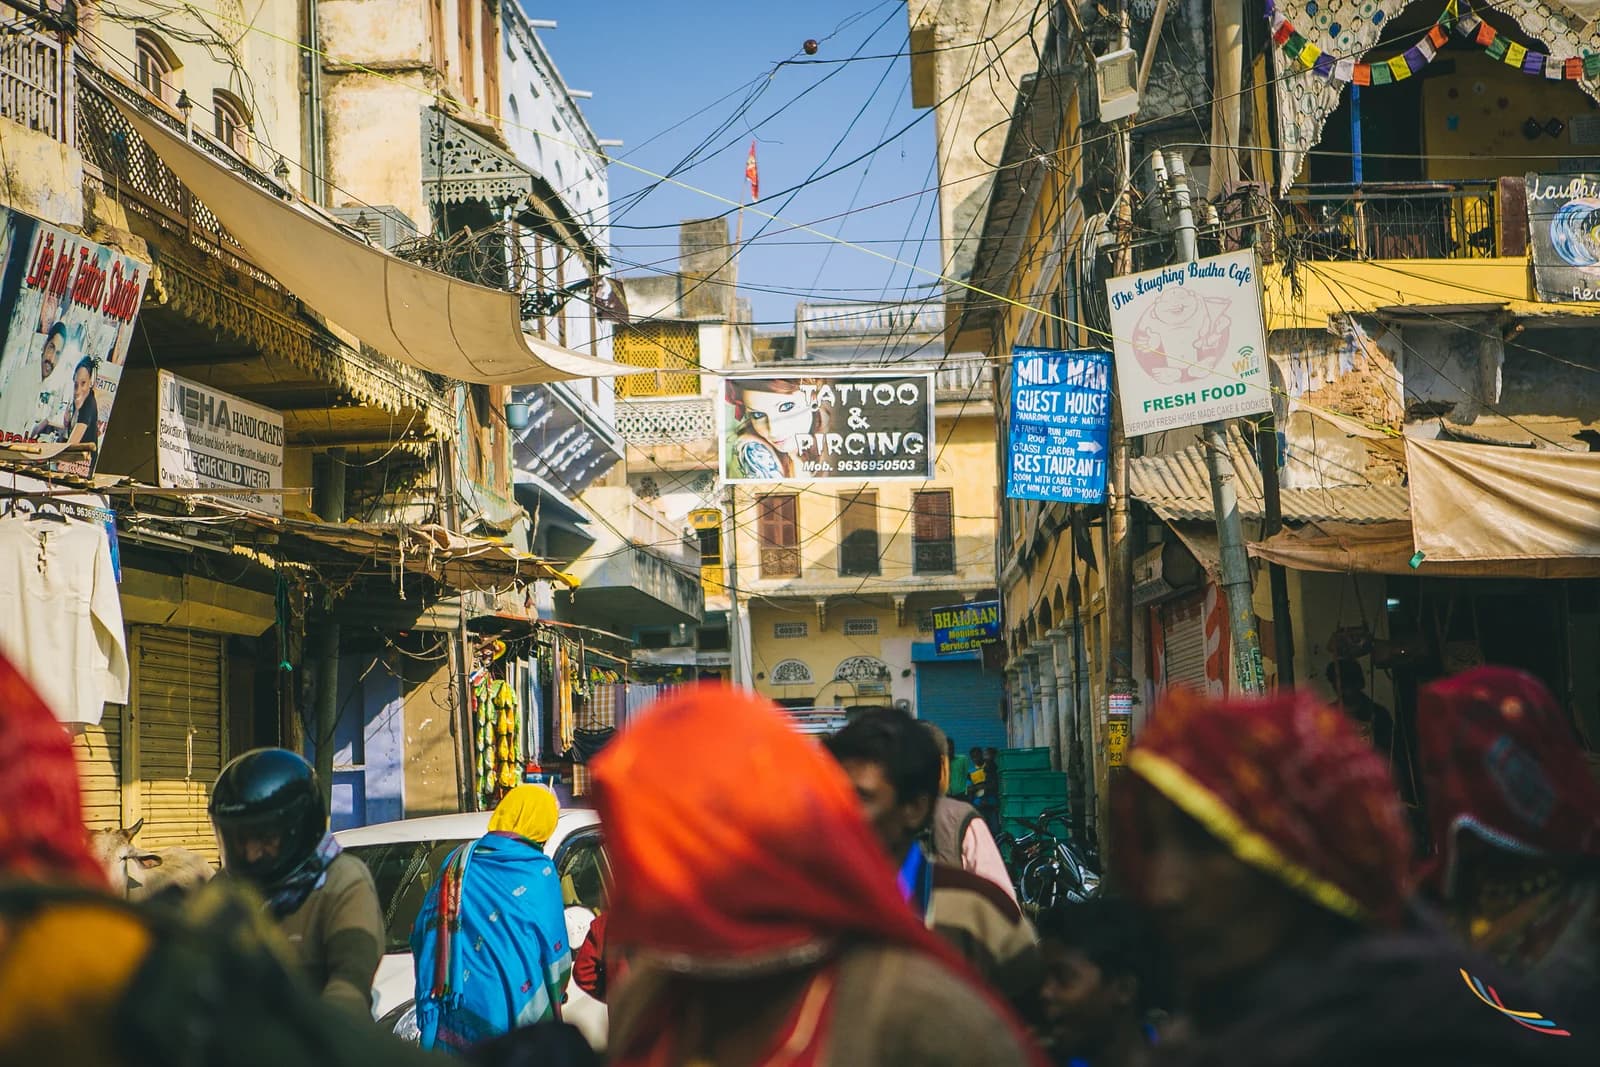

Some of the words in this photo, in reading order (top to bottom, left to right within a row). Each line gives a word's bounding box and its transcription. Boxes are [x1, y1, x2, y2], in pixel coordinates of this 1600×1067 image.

[1530, 174, 1600, 201] Laughi
[26, 230, 54, 292] Life
[49, 239, 75, 300] Ink
[70, 247, 107, 313] Tattoo
[103, 260, 140, 325] Studio
[1111, 291, 1134, 310] The
[1134, 267, 1185, 295] Laughing
[1188, 262, 1225, 278] Budha
[1229, 263, 1252, 286] Cafe
[1017, 357, 1061, 387] MILK
[1067, 358, 1108, 391] MAN
[1240, 368, 1260, 379] FREE
[800, 383, 919, 407] TATTOO
[1016, 390, 1060, 413] GUEST
[1065, 392, 1107, 415] HOUSE
[1143, 392, 1196, 413] FRESH
[1202, 382, 1246, 402] FOOD
[169, 382, 233, 433] NEHA
[847, 407, 870, 430] &
[1125, 420, 1157, 433] EVERYDAY
[1157, 415, 1177, 426] FRESH
[1178, 411, 1196, 423] HOME
[1198, 407, 1216, 419] MADE
[1217, 404, 1233, 415] CAKE
[1241, 398, 1270, 410] COOKIES
[1053, 415, 1067, 423] VIEW
[1070, 416, 1078, 424] OF
[1082, 417, 1105, 425] NATURE
[1021, 425, 1043, 434] FAMILY
[1047, 427, 1061, 436] RUN
[1065, 428, 1082, 438] HOTEL
[1027, 434, 1047, 444] ROOF
[1053, 436, 1067, 445] TOP
[795, 432, 924, 456] PIRCING
[1046, 446, 1075, 456] GARDEN
[184, 449, 217, 476] MEGHA
[217, 457, 242, 483] CHILD
[243, 467, 270, 488] WEAR
[803, 461, 833, 472] Mob.
[837, 460, 915, 471] 9636950503
[1014, 455, 1104, 477] RESTAURANT
[1012, 483, 1026, 494] A/C
[1027, 484, 1040, 492] NON
[1041, 485, 1050, 496] AC
[1052, 485, 1061, 493] RS
[1062, 486, 1072, 497] 100
[1013, 473, 1031, 482] ROOM
[1035, 475, 1050, 484] WITH
[1052, 476, 1072, 485] CABLE
[1077, 478, 1087, 487] TV
[60, 503, 75, 515] Mob.
[76, 507, 113, 523] 9636950503
[934, 607, 997, 629] BHAIJAAN
[941, 641, 969, 652] Service
